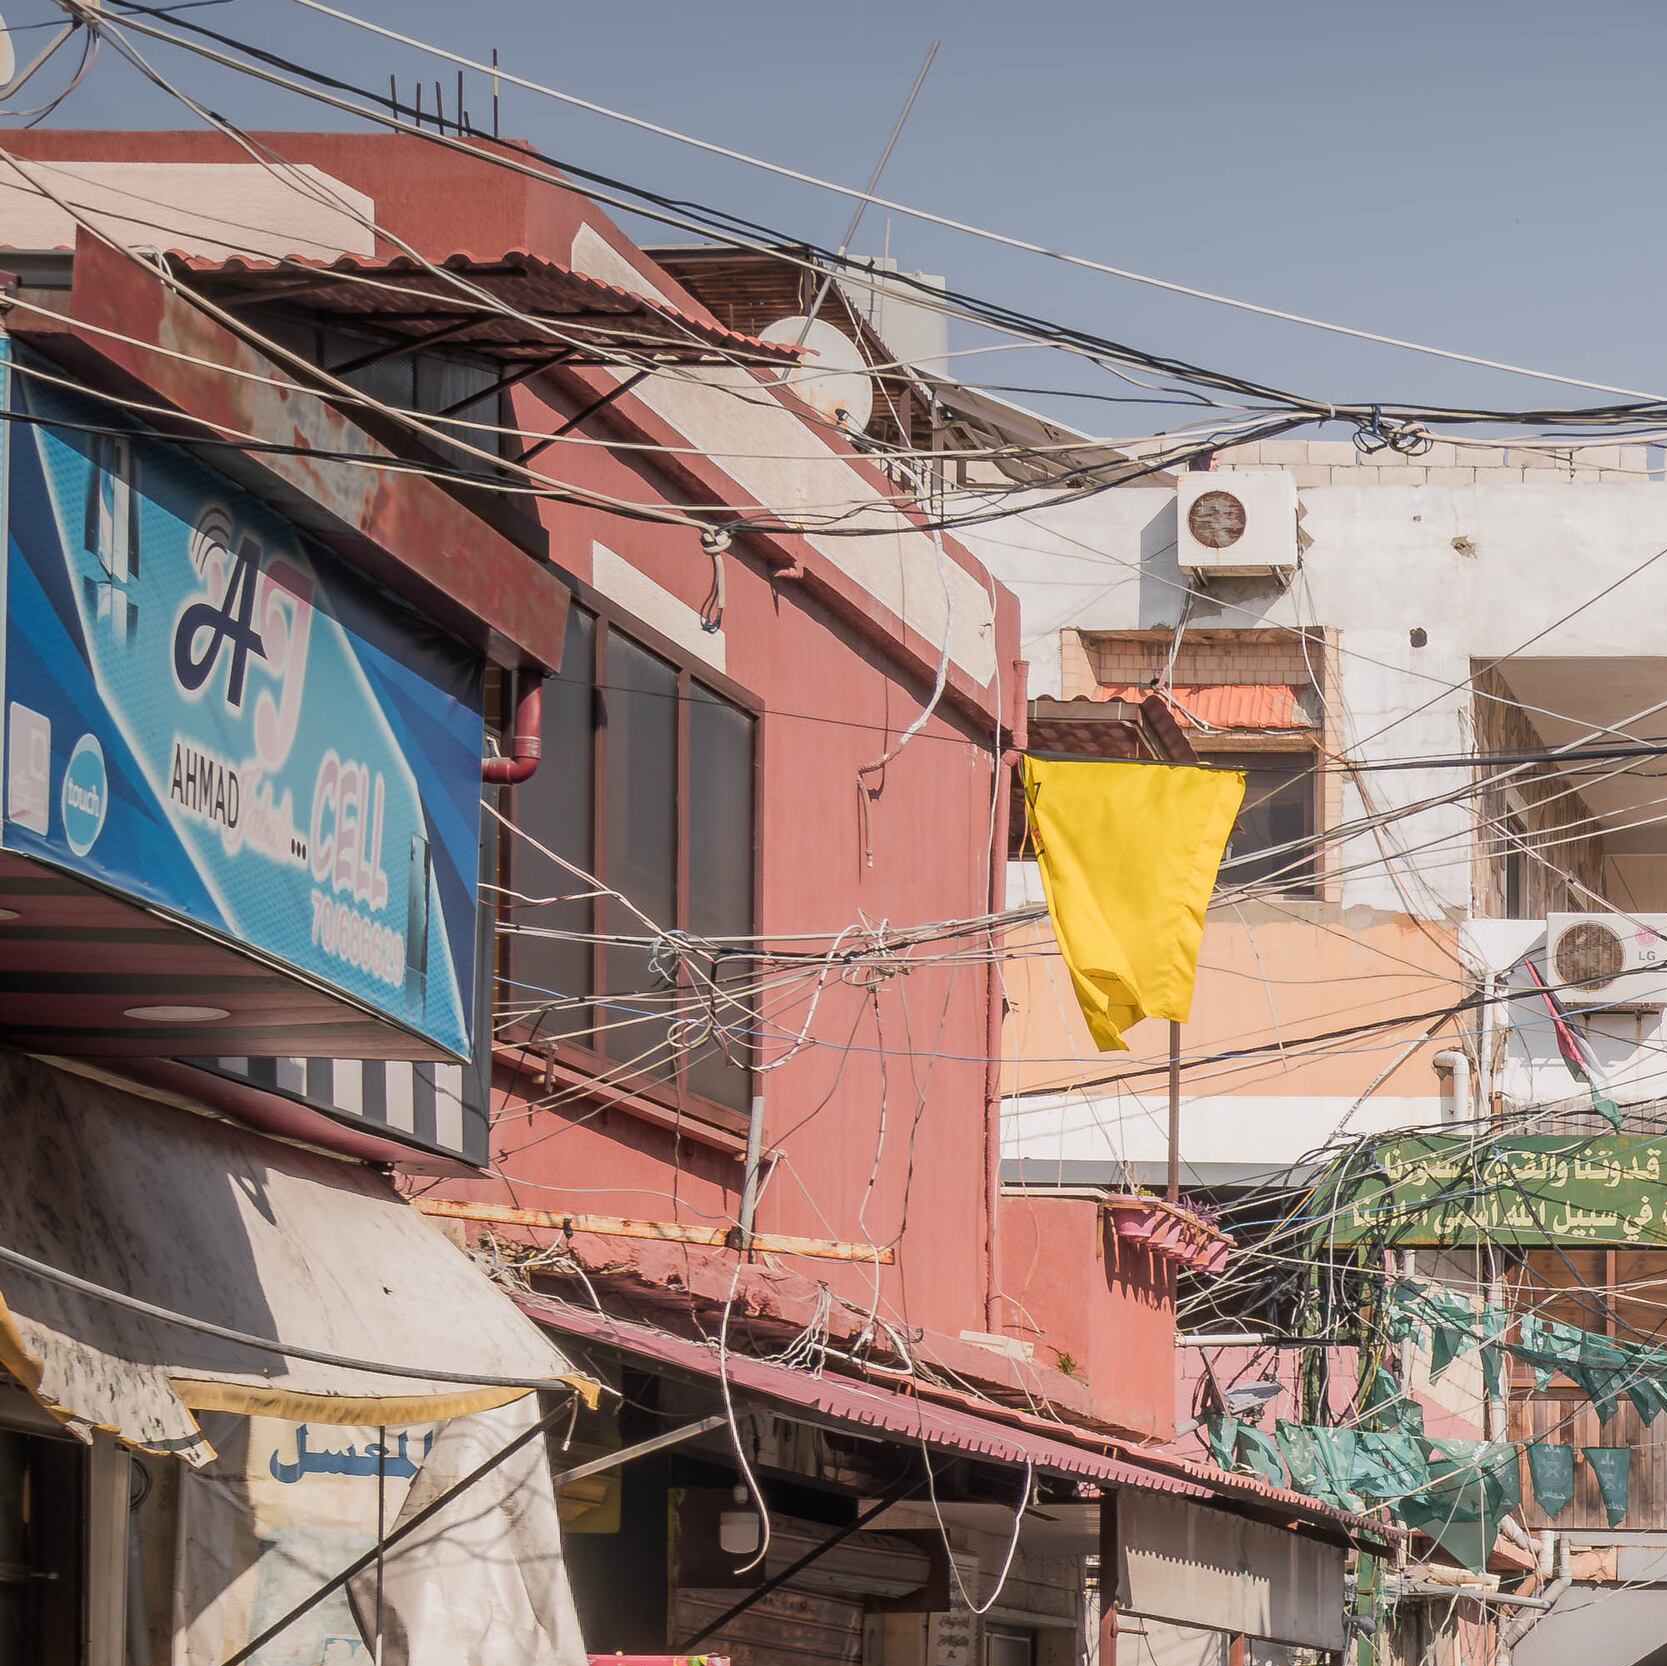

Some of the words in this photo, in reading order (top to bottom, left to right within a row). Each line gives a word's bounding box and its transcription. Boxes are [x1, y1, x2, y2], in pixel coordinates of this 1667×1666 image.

[67, 778, 101, 817] touch
[170, 743, 240, 830] AHMAD
[311, 749, 388, 912] CELL
[1638, 950, 1656, 961] LG
[1574, 1147, 1662, 1188] قدوتنا
[1502, 1196, 1546, 1227] الله
[1553, 1200, 1619, 1237] سبيل
[1622, 1195, 1655, 1242] في
